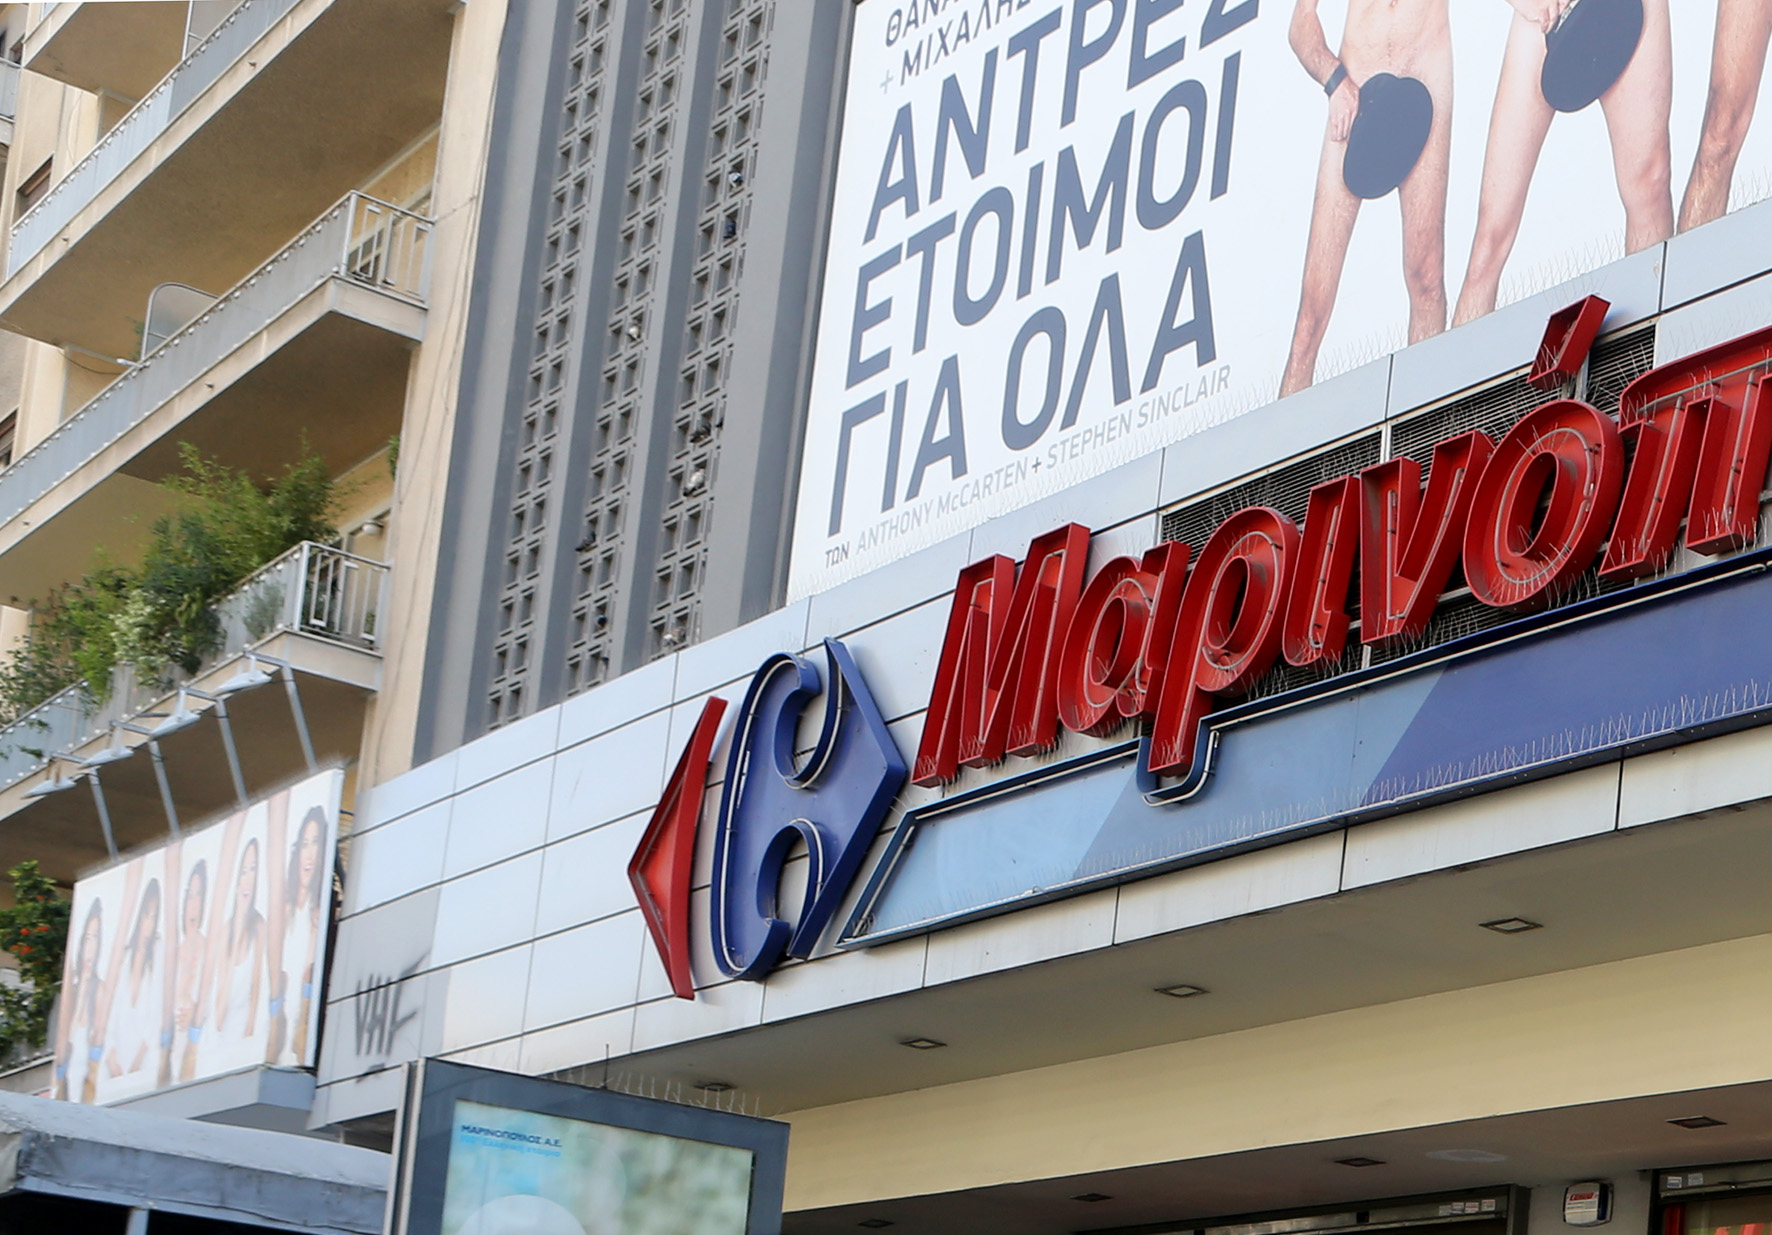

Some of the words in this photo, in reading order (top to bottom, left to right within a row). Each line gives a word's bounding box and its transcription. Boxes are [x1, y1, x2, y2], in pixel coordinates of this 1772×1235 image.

[845, 49, 1242, 391] ΕΤΟΙΜΟΙ
[825, 541, 850, 569] ΤΩΝ
[856, 502, 935, 553] ANTHONY
[938, 458, 1028, 520] McCARTEN
[1046, 414, 1132, 469] STEPHEN
[1136, 365, 1231, 430] SINCLAIR
[827, 353, 969, 538] ΓΙΑ
[1001, 229, 1217, 452] ΟΛΑ
